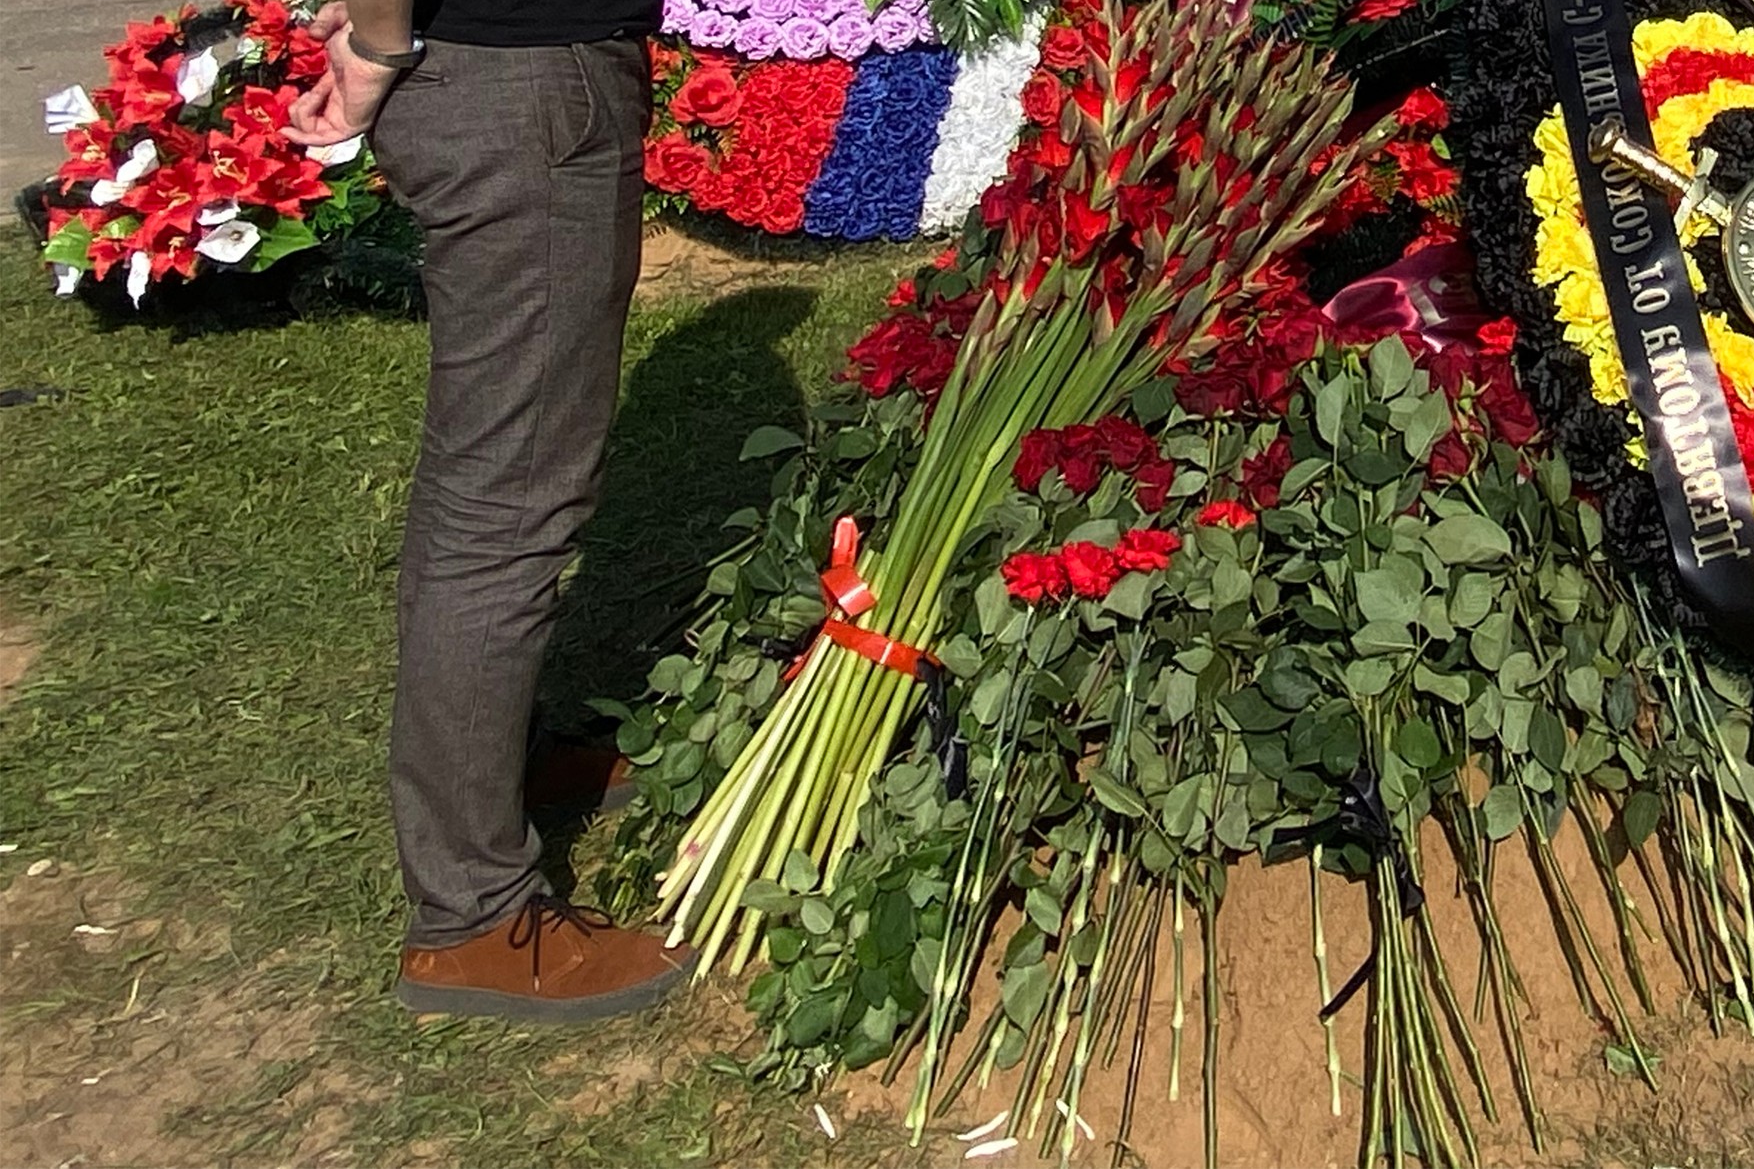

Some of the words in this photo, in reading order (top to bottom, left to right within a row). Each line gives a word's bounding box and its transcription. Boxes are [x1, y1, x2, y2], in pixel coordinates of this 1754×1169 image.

[1573, 29, 1653, 252] СОКОЬНИКА
[1625, 262, 1671, 313] ОТ
[1641, 325, 1750, 567] ДЕВЯТОМУ
